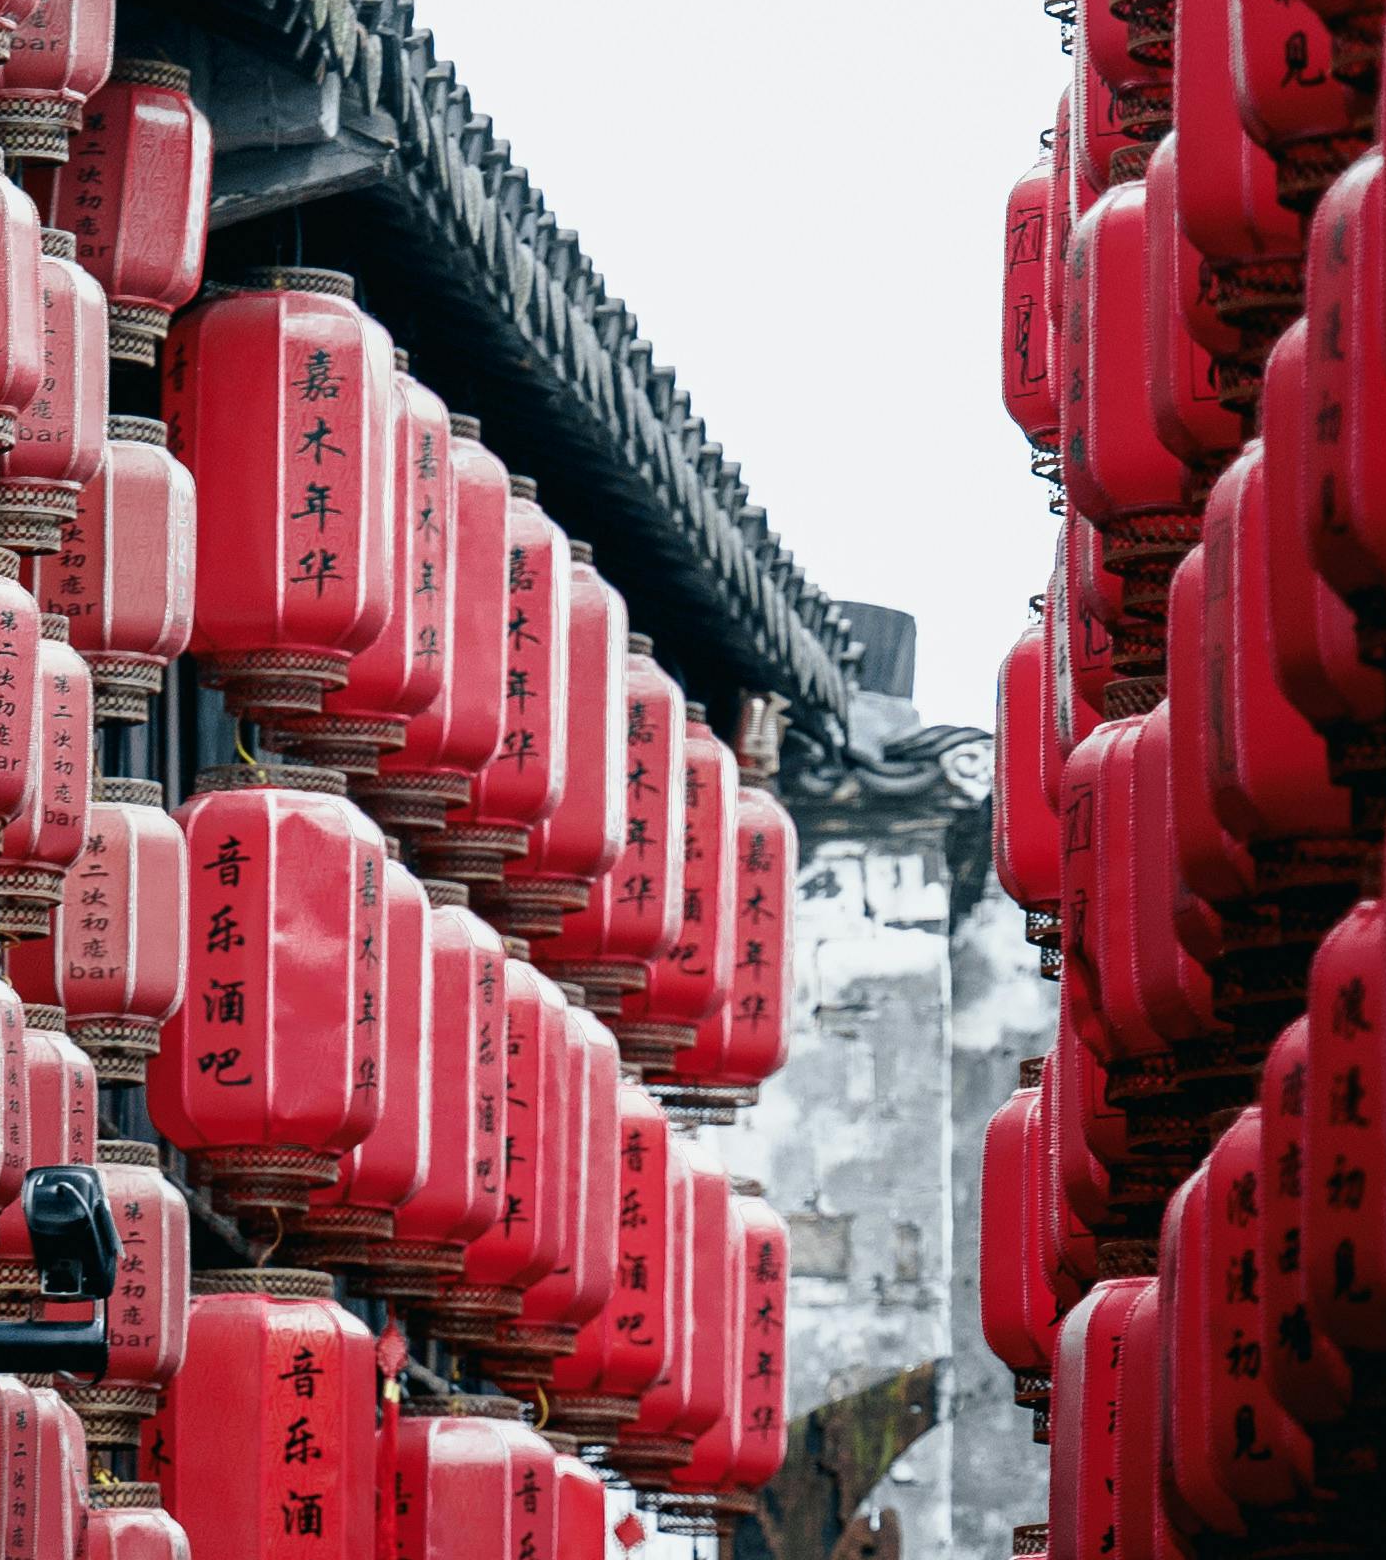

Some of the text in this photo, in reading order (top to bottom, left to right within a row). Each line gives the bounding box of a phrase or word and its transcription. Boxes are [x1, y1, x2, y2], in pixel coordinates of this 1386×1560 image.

[76, 113, 104, 236] 第二次初恋
[18, 424, 68, 443] bar
[291, 349, 345, 596] 嘉木年华
[48, 597, 96, 618] bar
[414, 433, 440, 670] 嘉木年华
[44, 676, 81, 827] 第二次初恋 bar
[499, 546, 539, 773] 嘉木年华
[619, 699, 658, 911] 嘉木年华
[70, 835, 121, 981] 第二次初恋 bar
[199, 835, 252, 1087] 音乐酒吧
[734, 830, 774, 1033] 嘉木年华
[111, 1202, 152, 1348] 第二次初恋 bar
[618, 1130, 651, 1345] 音乐酒吧
[748, 1241, 781, 1441] 嘉木年华
